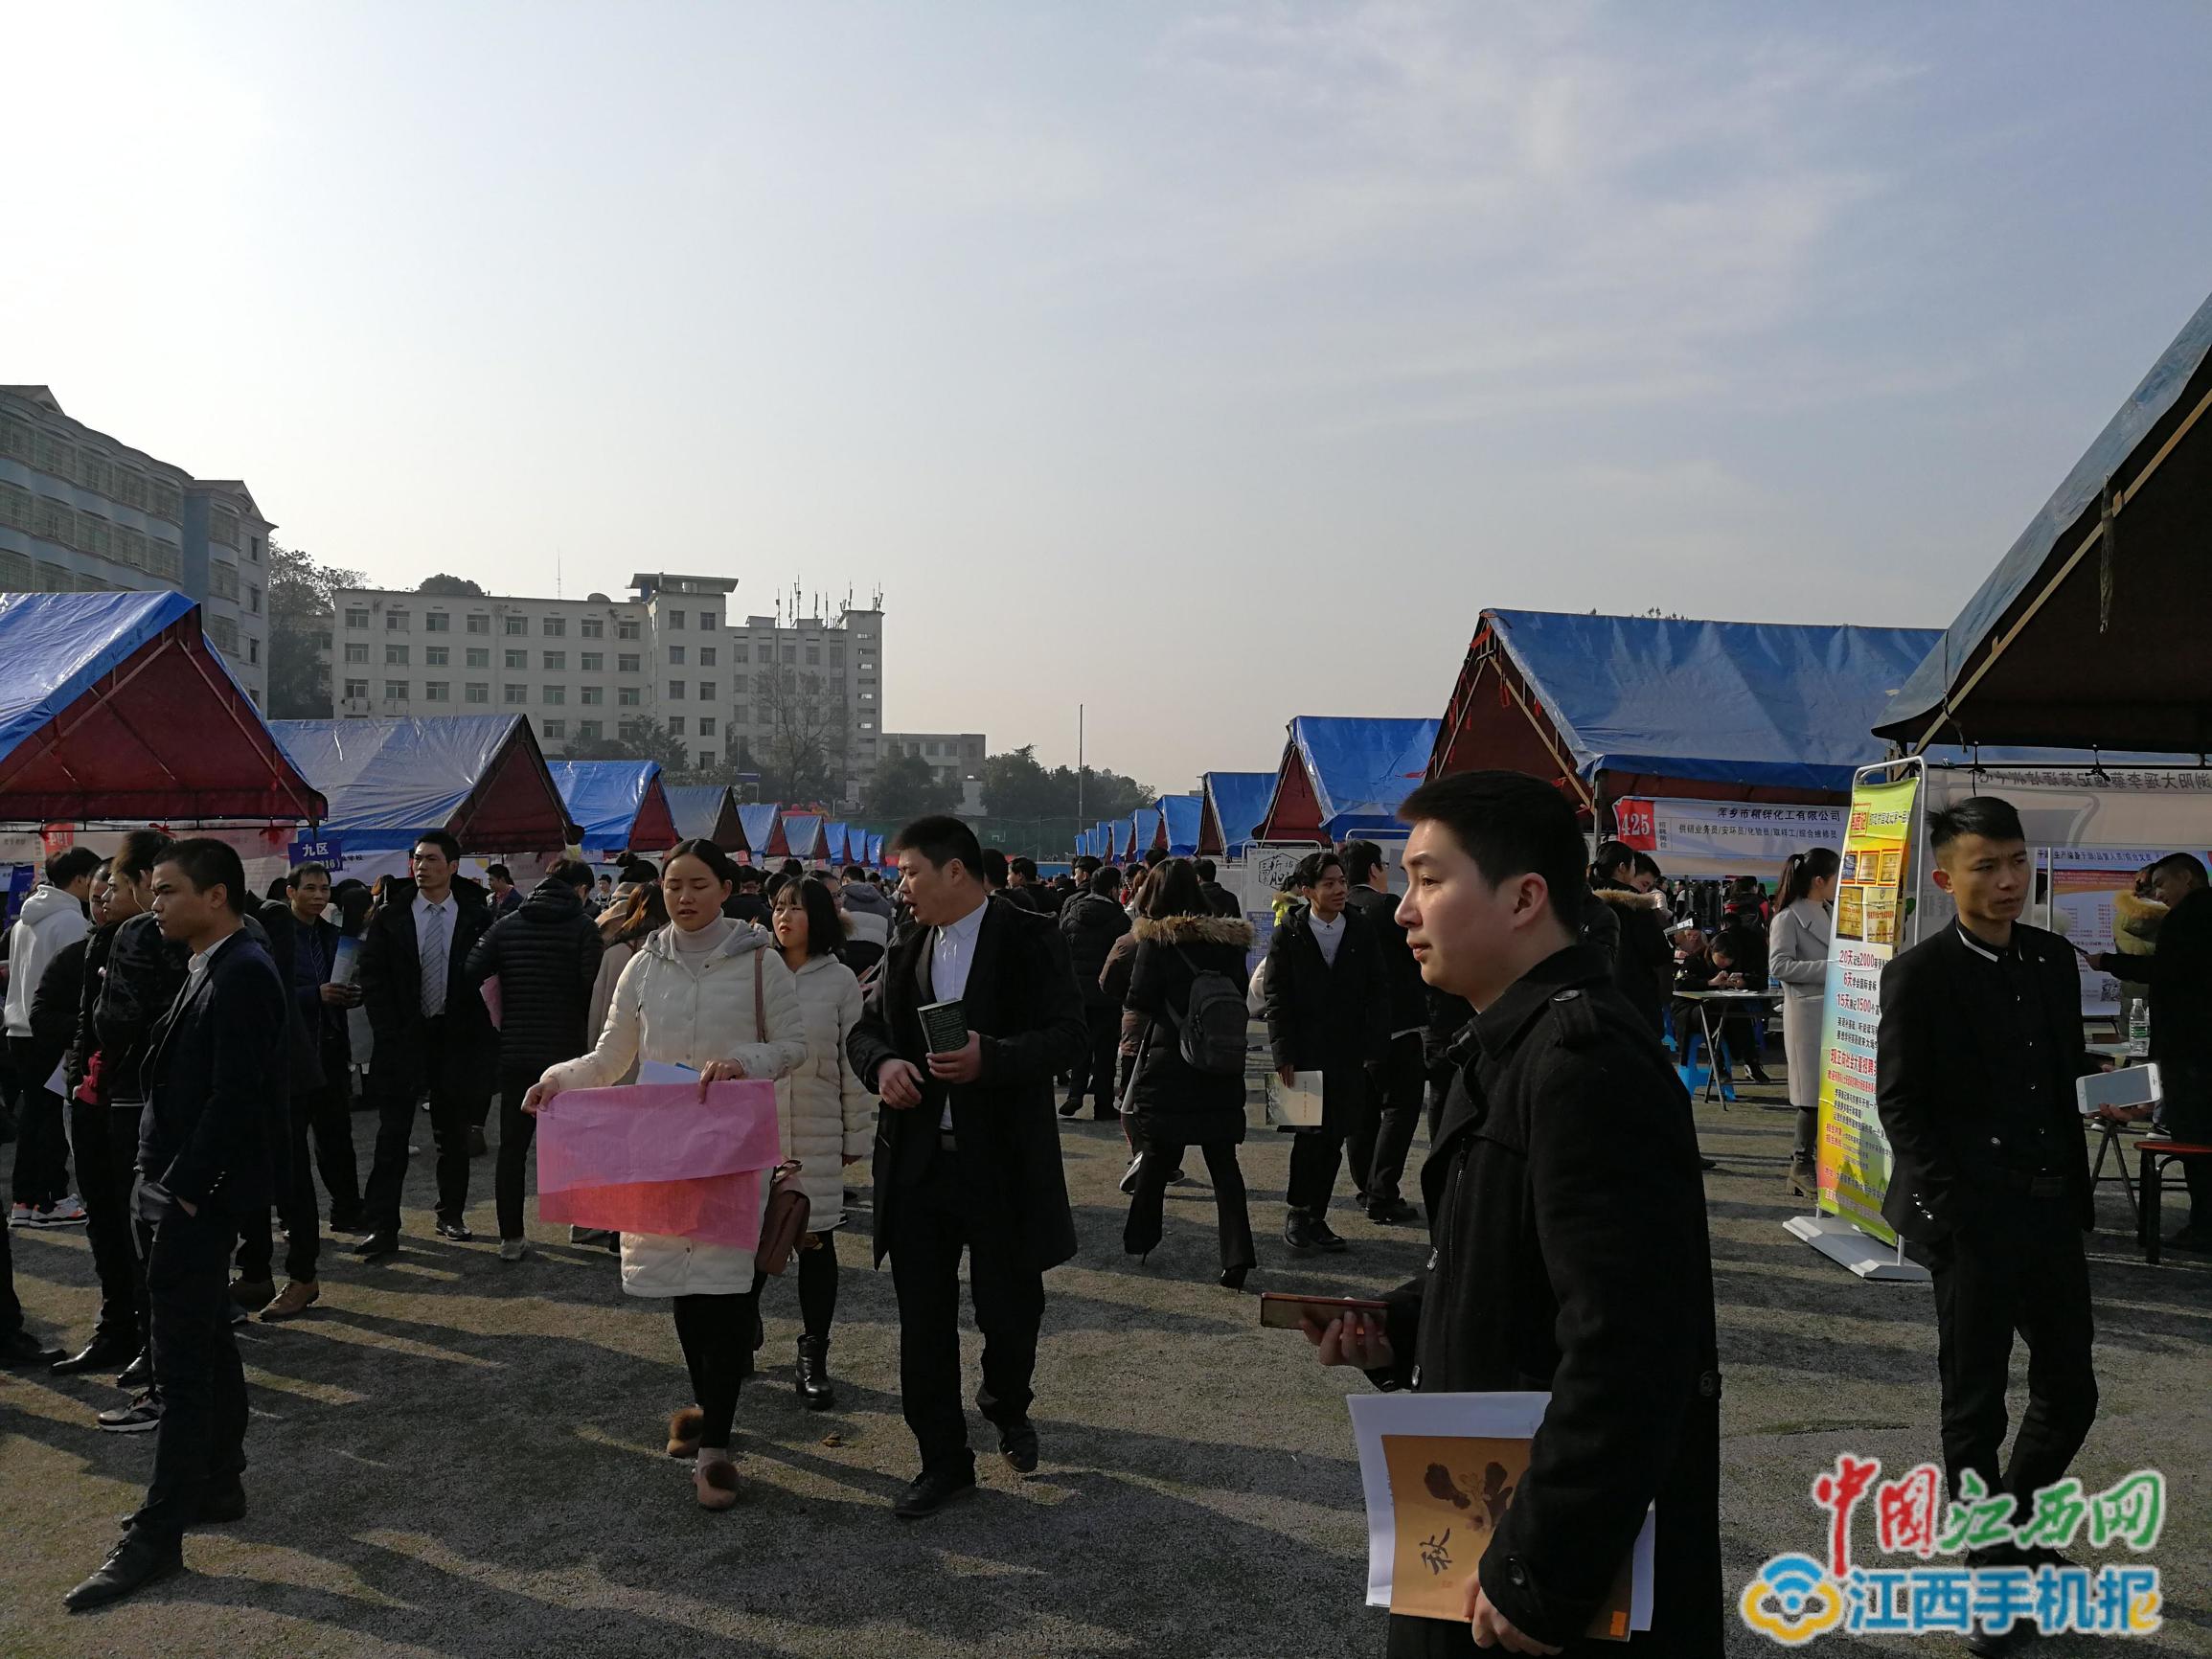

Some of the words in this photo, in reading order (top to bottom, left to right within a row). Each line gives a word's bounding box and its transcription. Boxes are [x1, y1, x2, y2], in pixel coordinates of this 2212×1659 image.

[1622, 813, 1650, 835] 425
[302, 842, 329, 856] 九区
[1419, 1528, 1452, 1576] 秋
